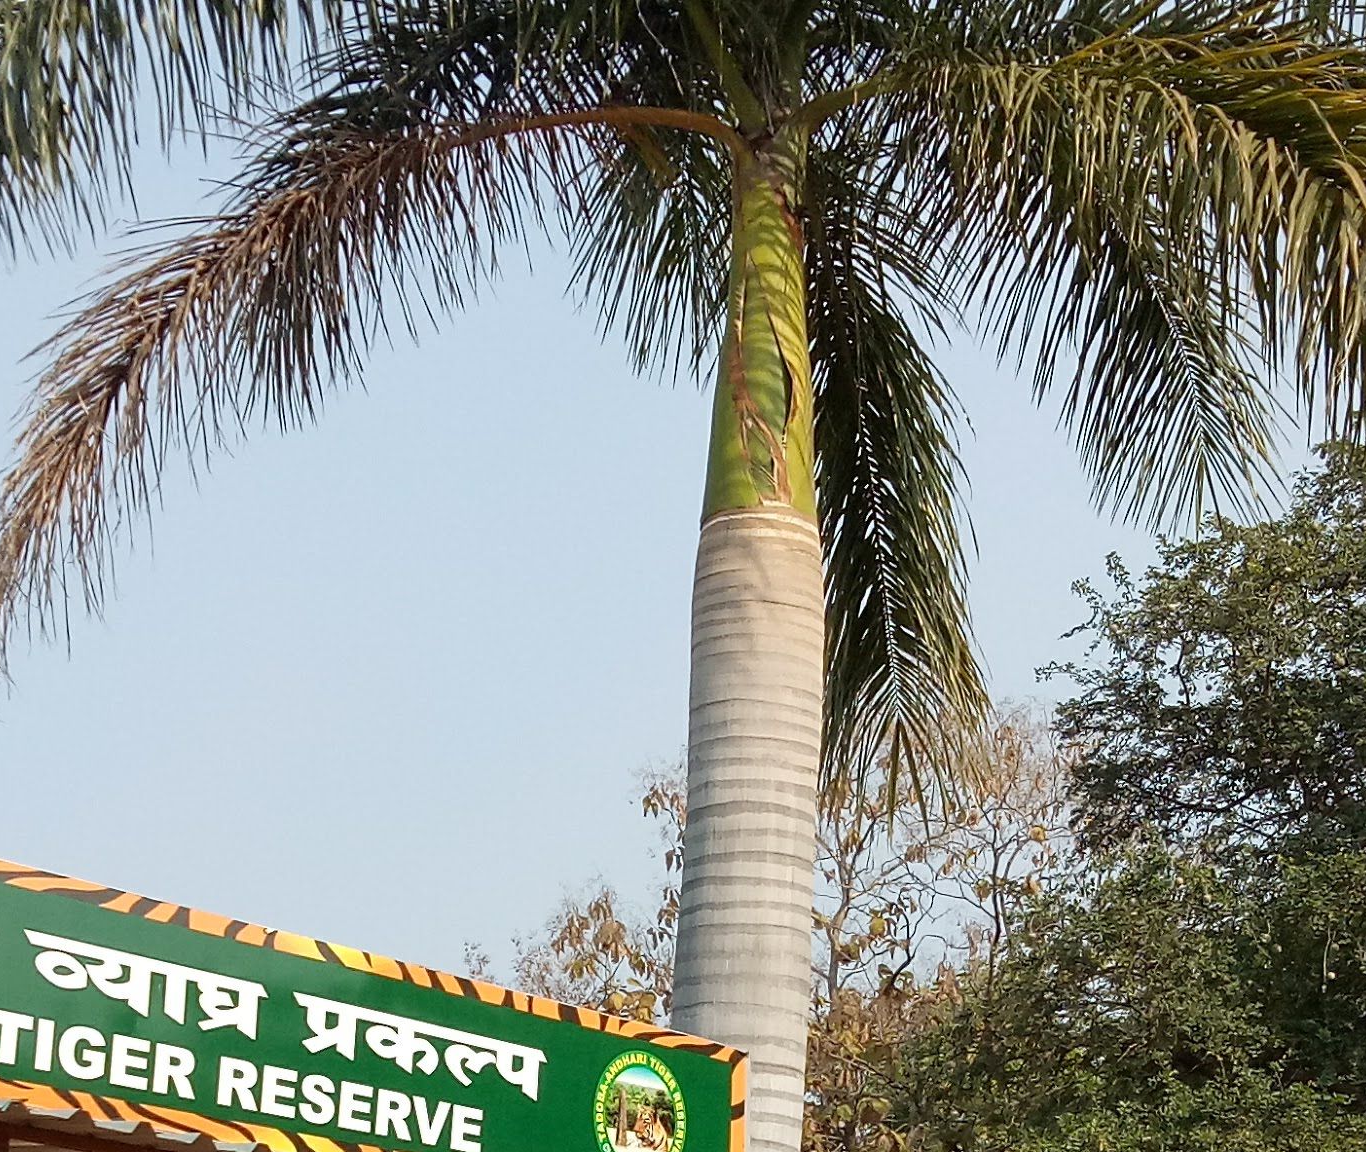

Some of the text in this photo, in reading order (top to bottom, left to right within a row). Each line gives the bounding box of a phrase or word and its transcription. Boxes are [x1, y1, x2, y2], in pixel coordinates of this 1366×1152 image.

[24, 928, 269, 1039] व्याघ्र
[293, 991, 547, 1101] प्रकल्प
[650, 1056, 677, 1091] TIGER
